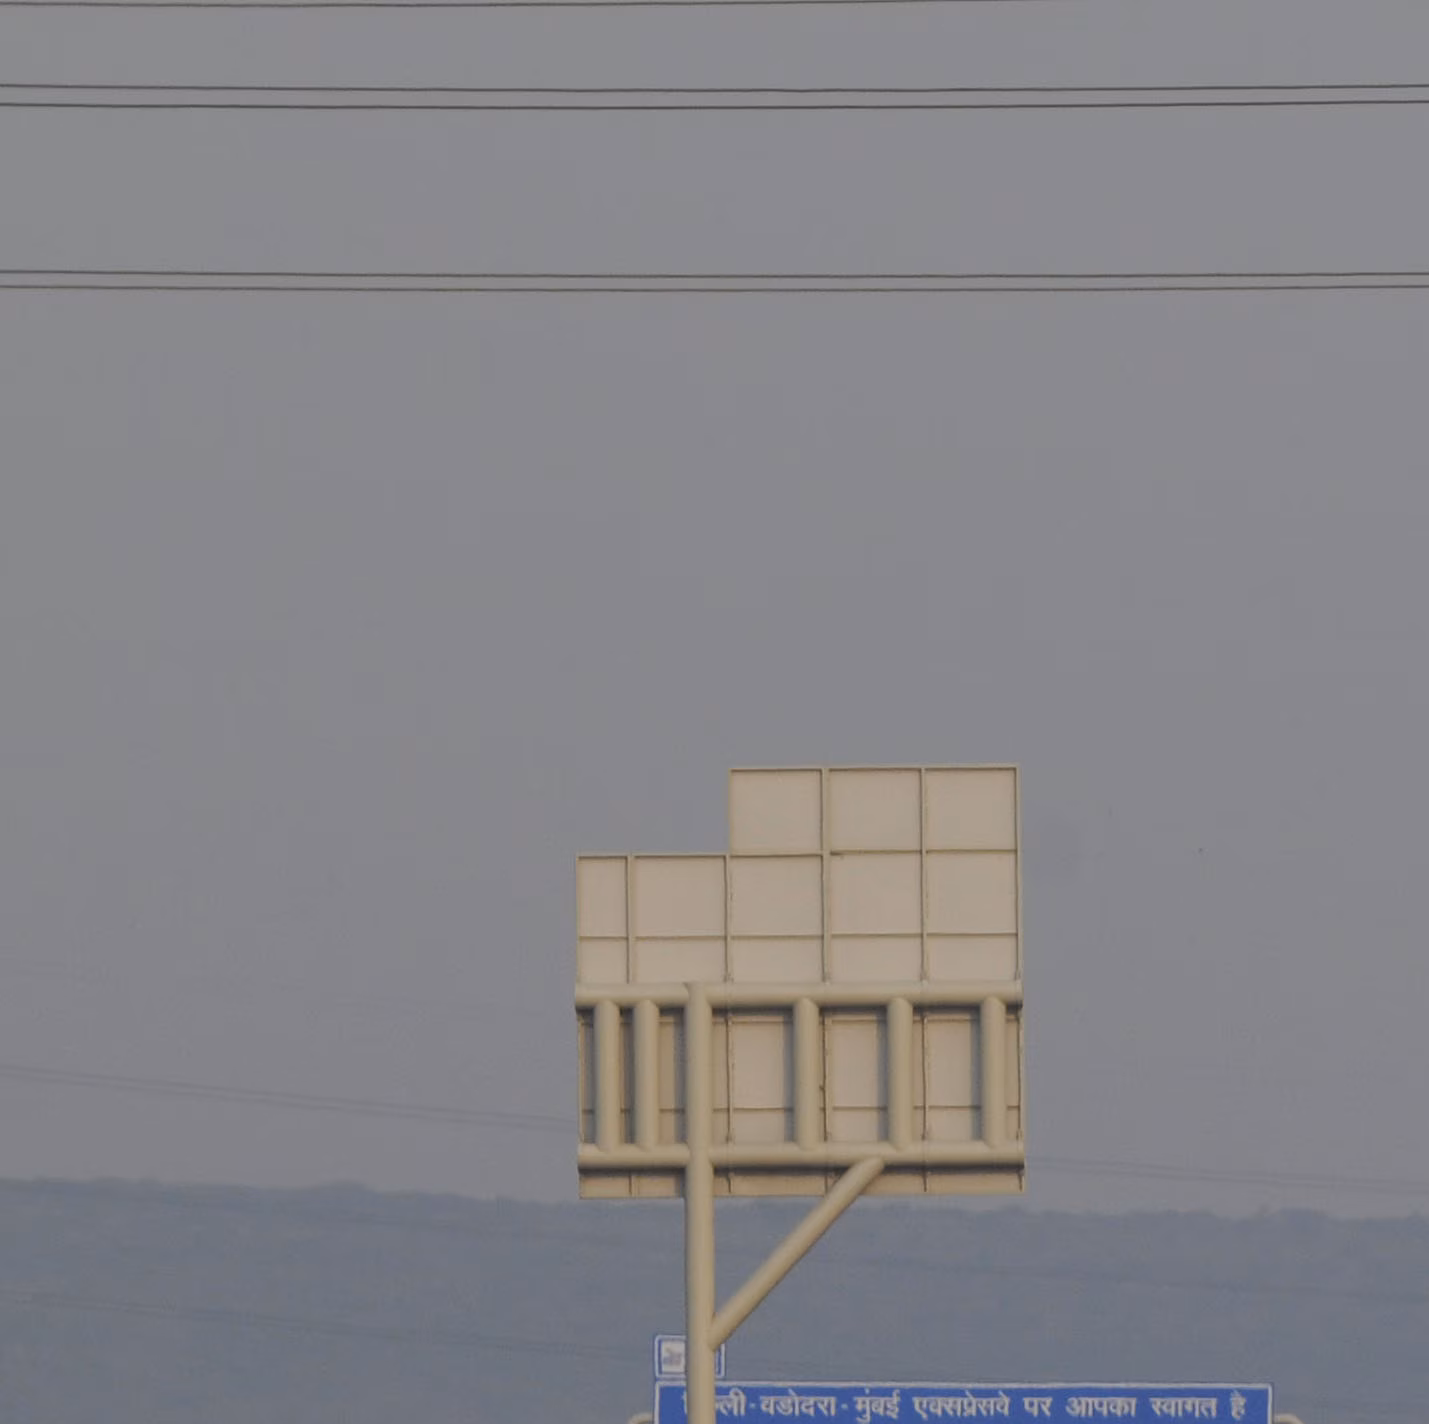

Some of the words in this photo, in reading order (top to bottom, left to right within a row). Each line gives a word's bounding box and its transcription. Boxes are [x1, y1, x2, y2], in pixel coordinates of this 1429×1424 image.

[1023, 1396, 1053, 1417] पर
[1066, 1396, 1136, 1417] आपका
[1149, 1396, 1217, 1418] स्वागत
[1229, 1389, 1246, 1420] है
